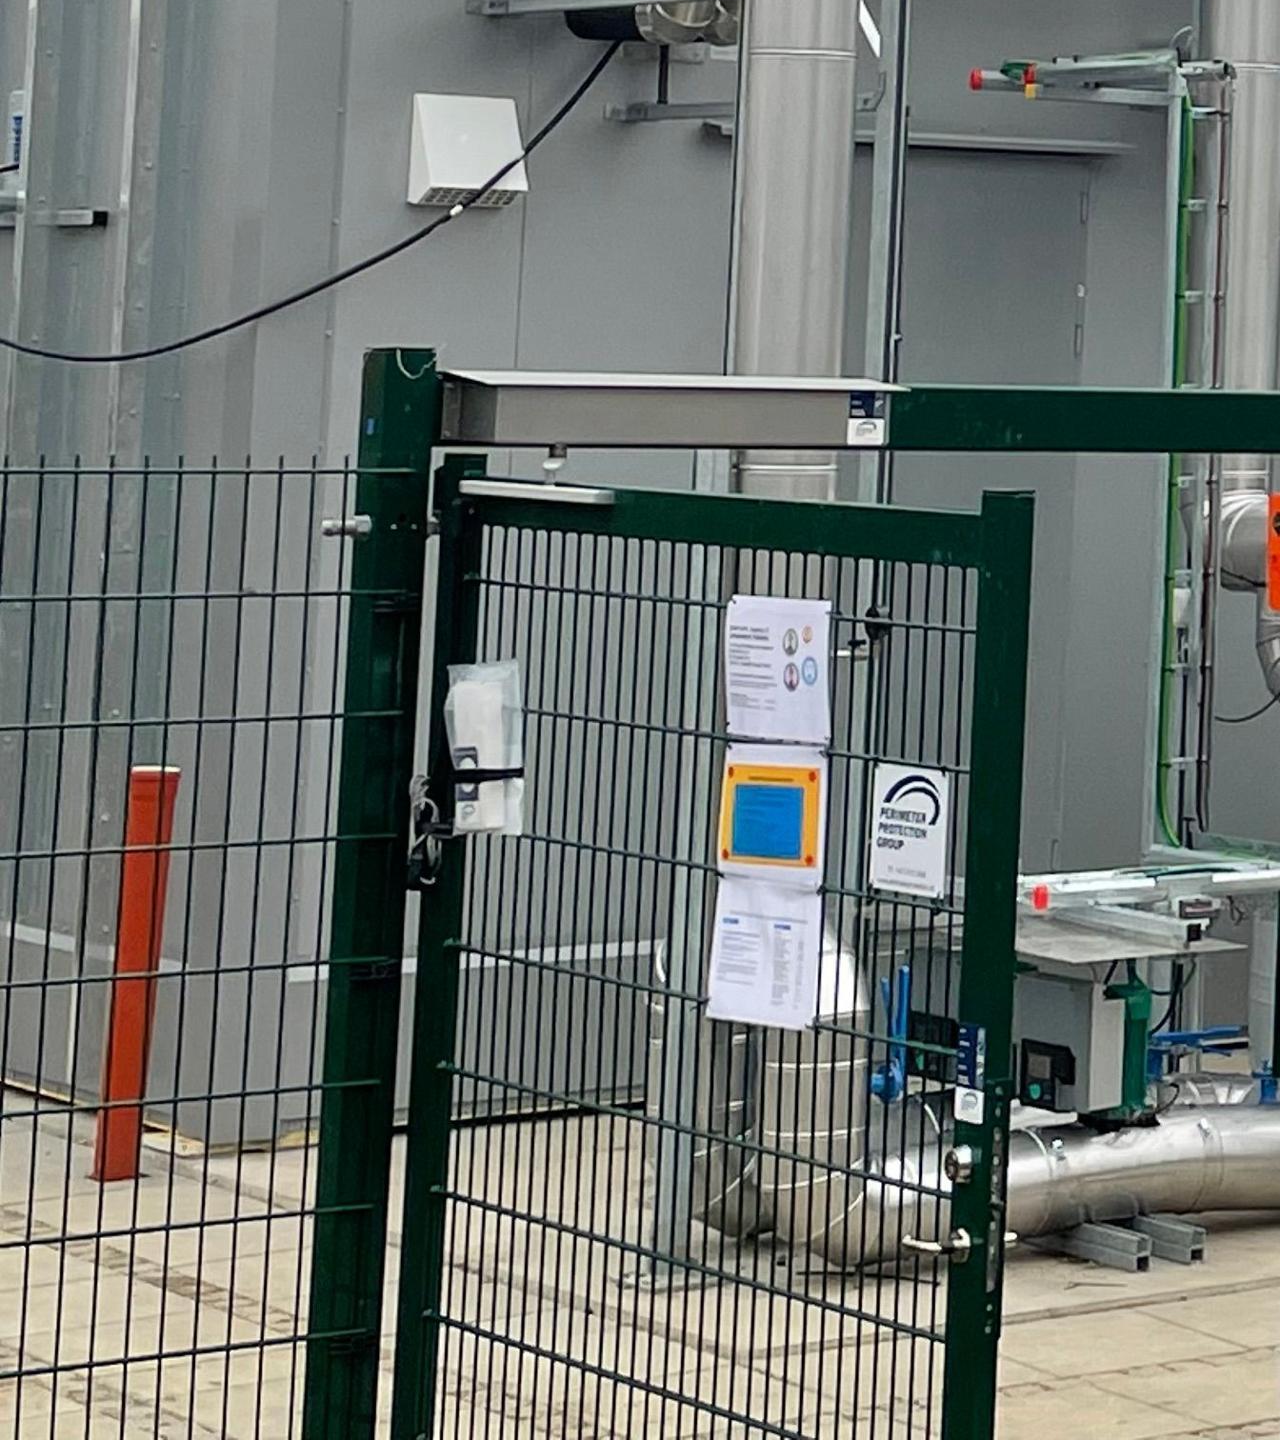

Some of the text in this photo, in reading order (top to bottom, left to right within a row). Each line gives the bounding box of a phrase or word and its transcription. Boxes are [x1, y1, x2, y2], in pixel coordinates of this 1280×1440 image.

[880, 807, 926, 823] PERIMETER
[878, 822, 927, 838] PROTECTION
[876, 836, 904, 850] GROUP
